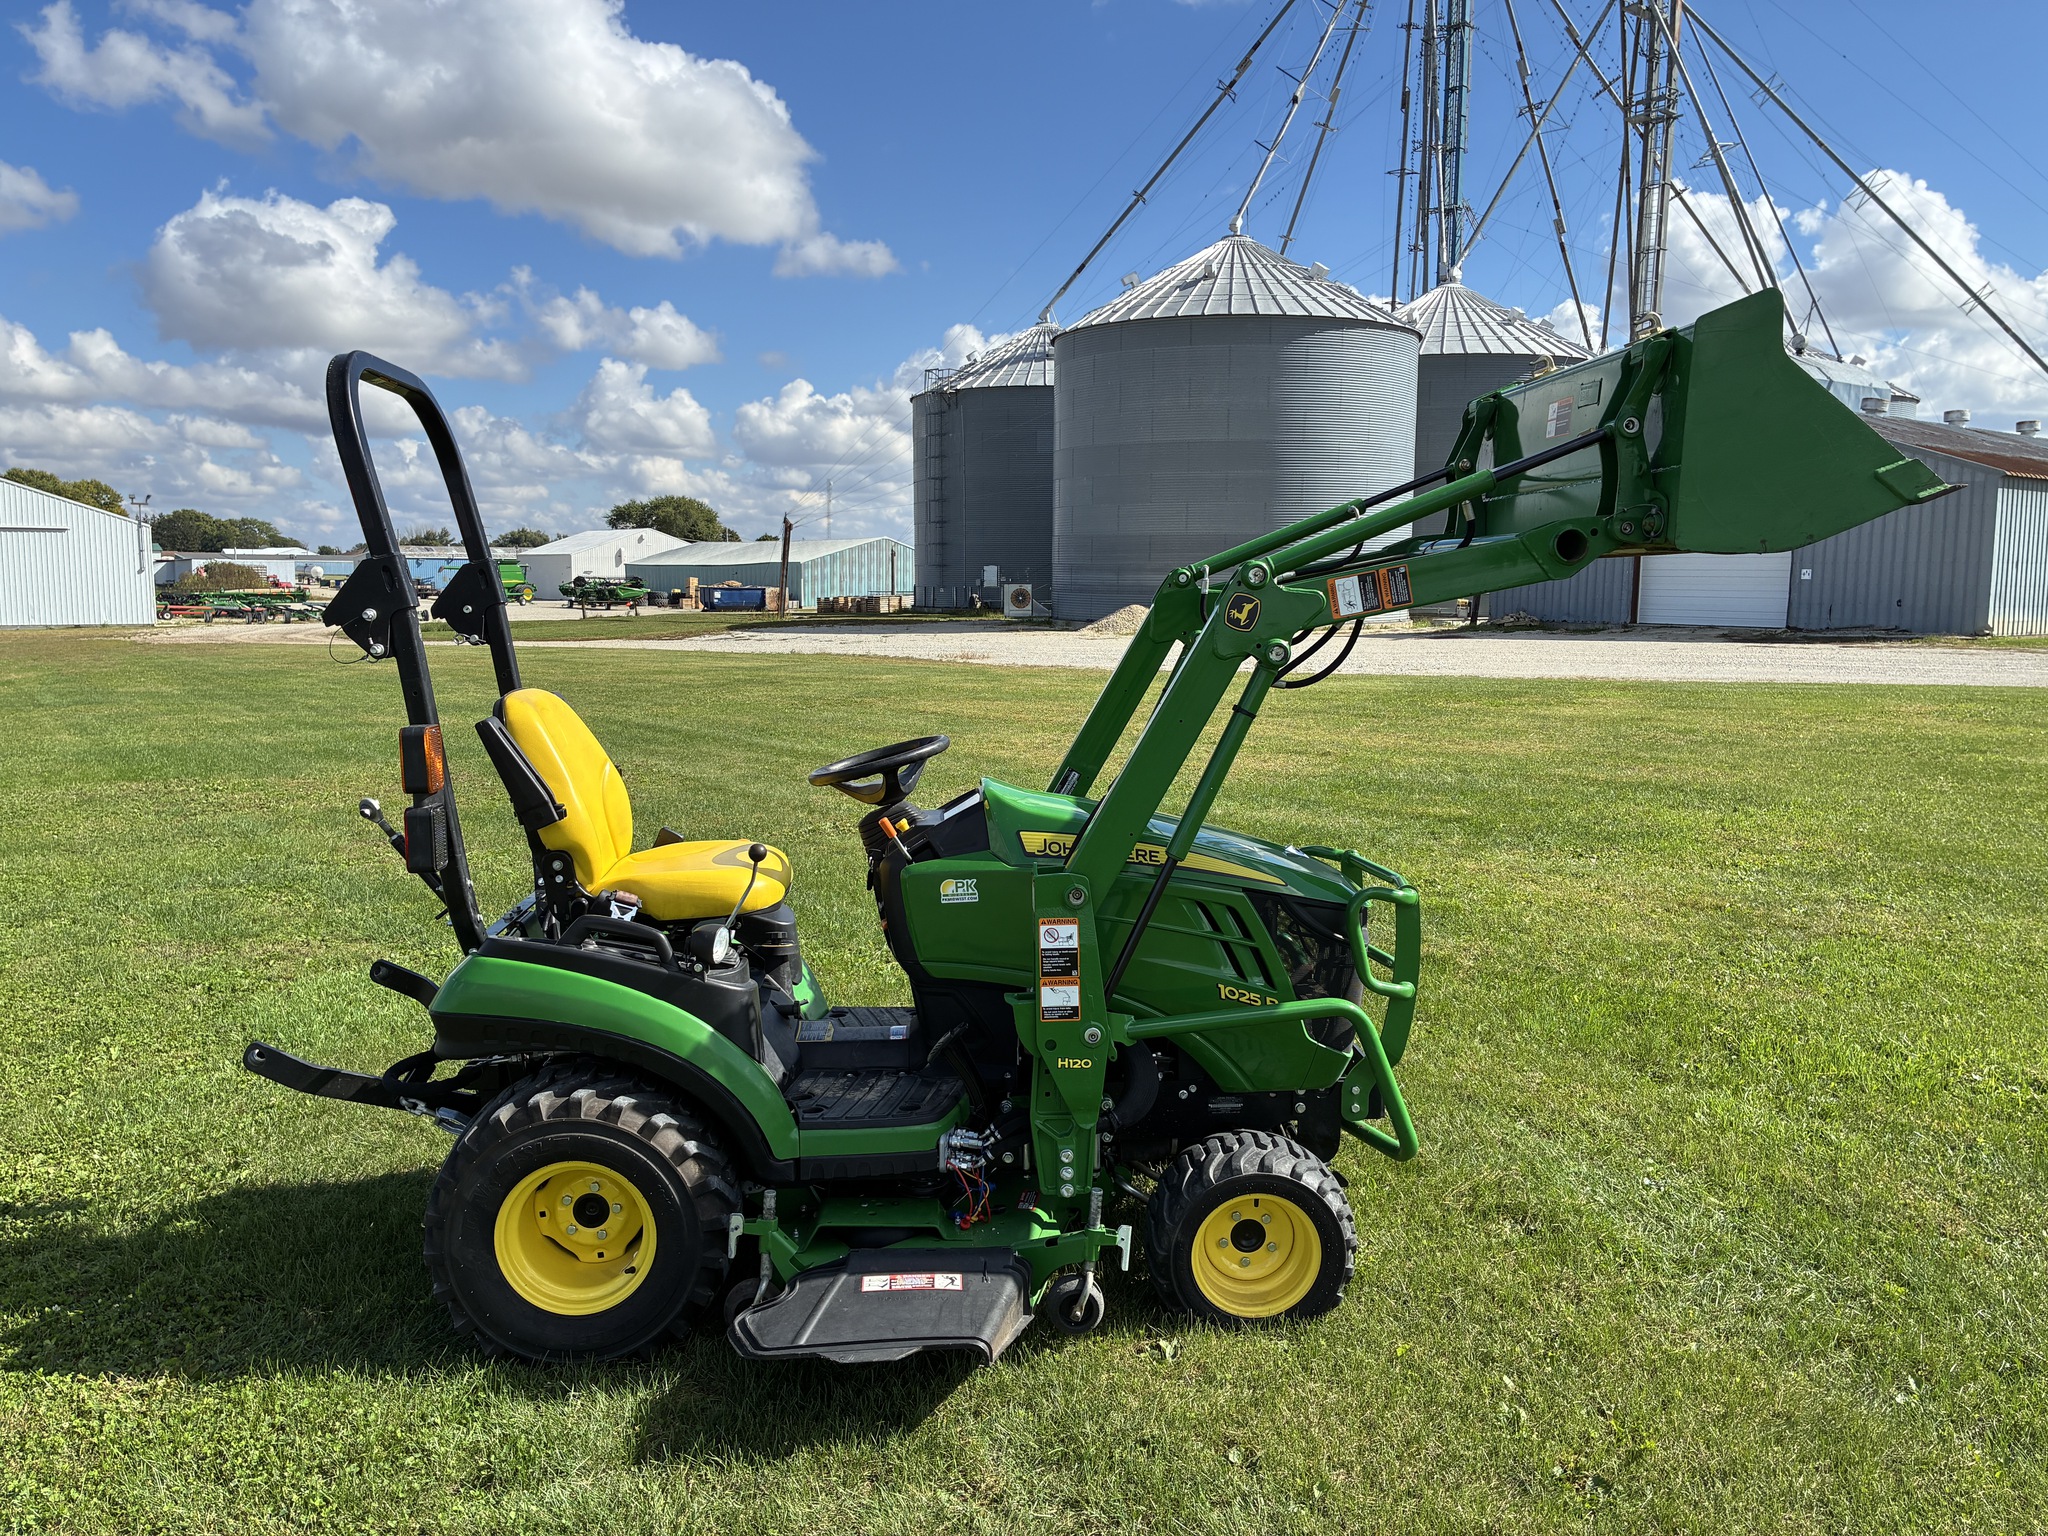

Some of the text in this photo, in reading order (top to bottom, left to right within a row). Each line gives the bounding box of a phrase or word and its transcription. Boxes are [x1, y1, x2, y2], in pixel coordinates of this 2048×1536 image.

[1381, 572, 1390, 598] WARNING
[1036, 838, 1072, 855] JOH
[955, 880, 977, 893] PK
[1217, 983, 1262, 1006] 1025
[1057, 1057, 1092, 1069] H120
